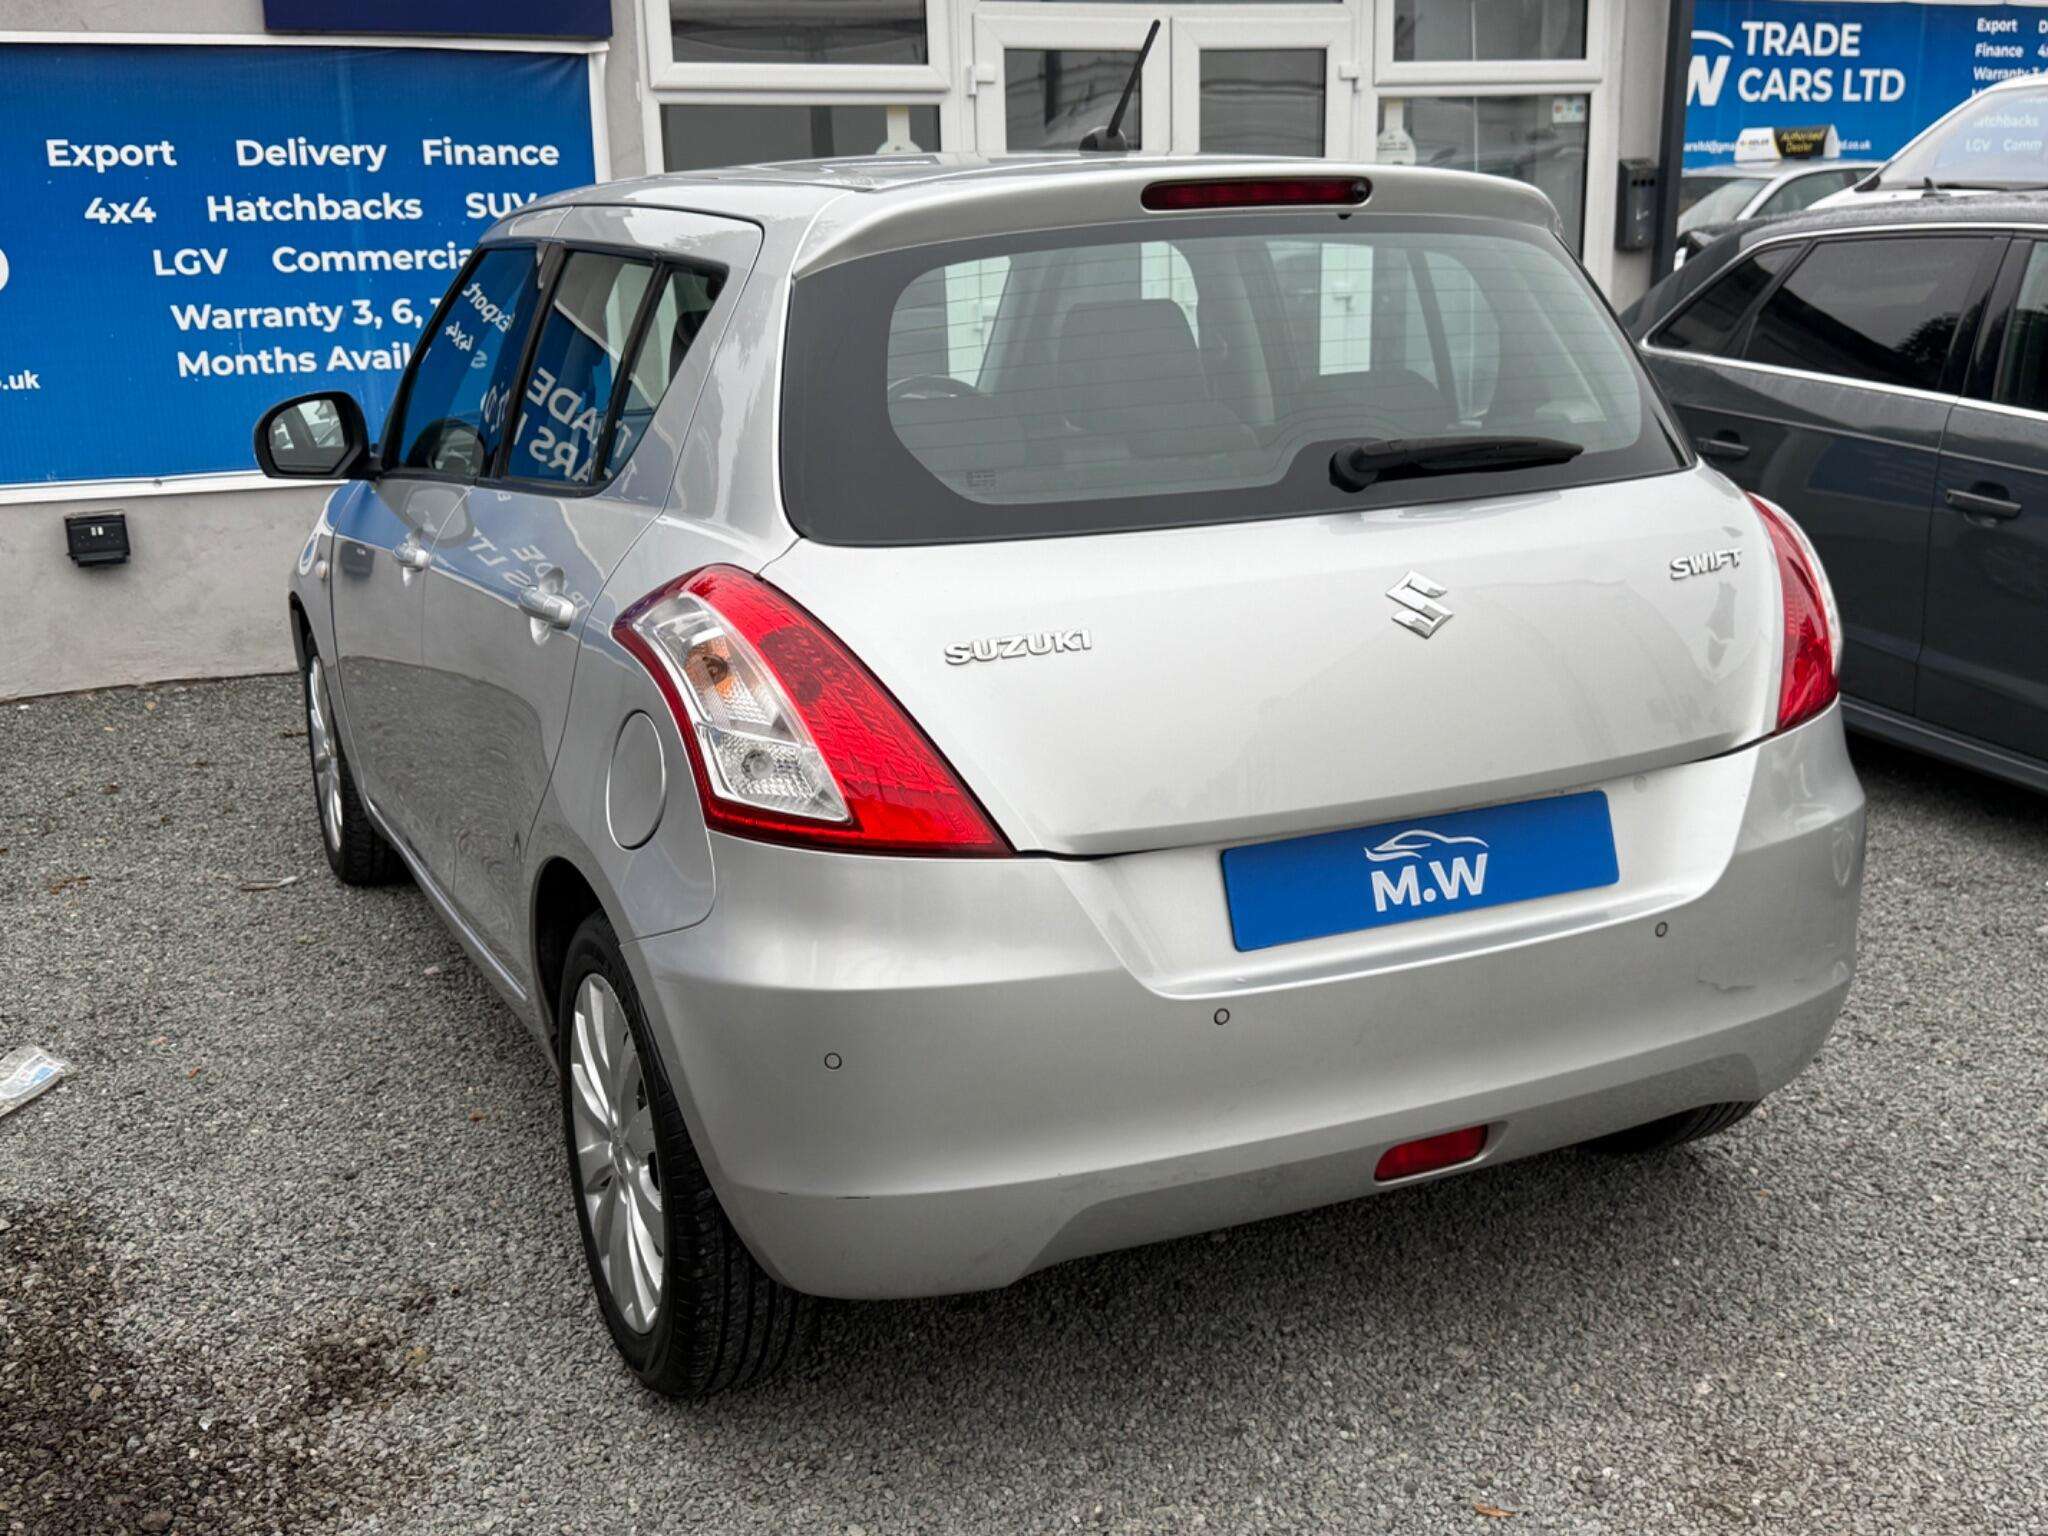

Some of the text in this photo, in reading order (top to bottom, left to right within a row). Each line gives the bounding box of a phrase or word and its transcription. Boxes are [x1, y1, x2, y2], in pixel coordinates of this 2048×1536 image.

[1740, 21, 1863, 57] TRADE
[1976, 17, 2017, 34] Export
[1974, 41, 2025, 58] Finance
[1737, 67, 1907, 102] CARS LTD
[46, 136, 560, 174] Export Delivery Finance
[2002, 138, 2043, 152] Comm
[84, 196, 157, 225] 4x4
[206, 192, 424, 223] Hatchbacks
[152, 240, 473, 277] LGV Commercia
[169, 301, 345, 334] Warranty
[351, 299, 384, 331] 3,
[391, 297, 424, 329] 6,
[177, 341, 412, 378] Months Avail
[0, 369, 41, 390] .uk
[1669, 547, 1742, 581] SWIFT
[944, 629, 1093, 666] SUZUKI
[1371, 852, 1488, 913] M.W
